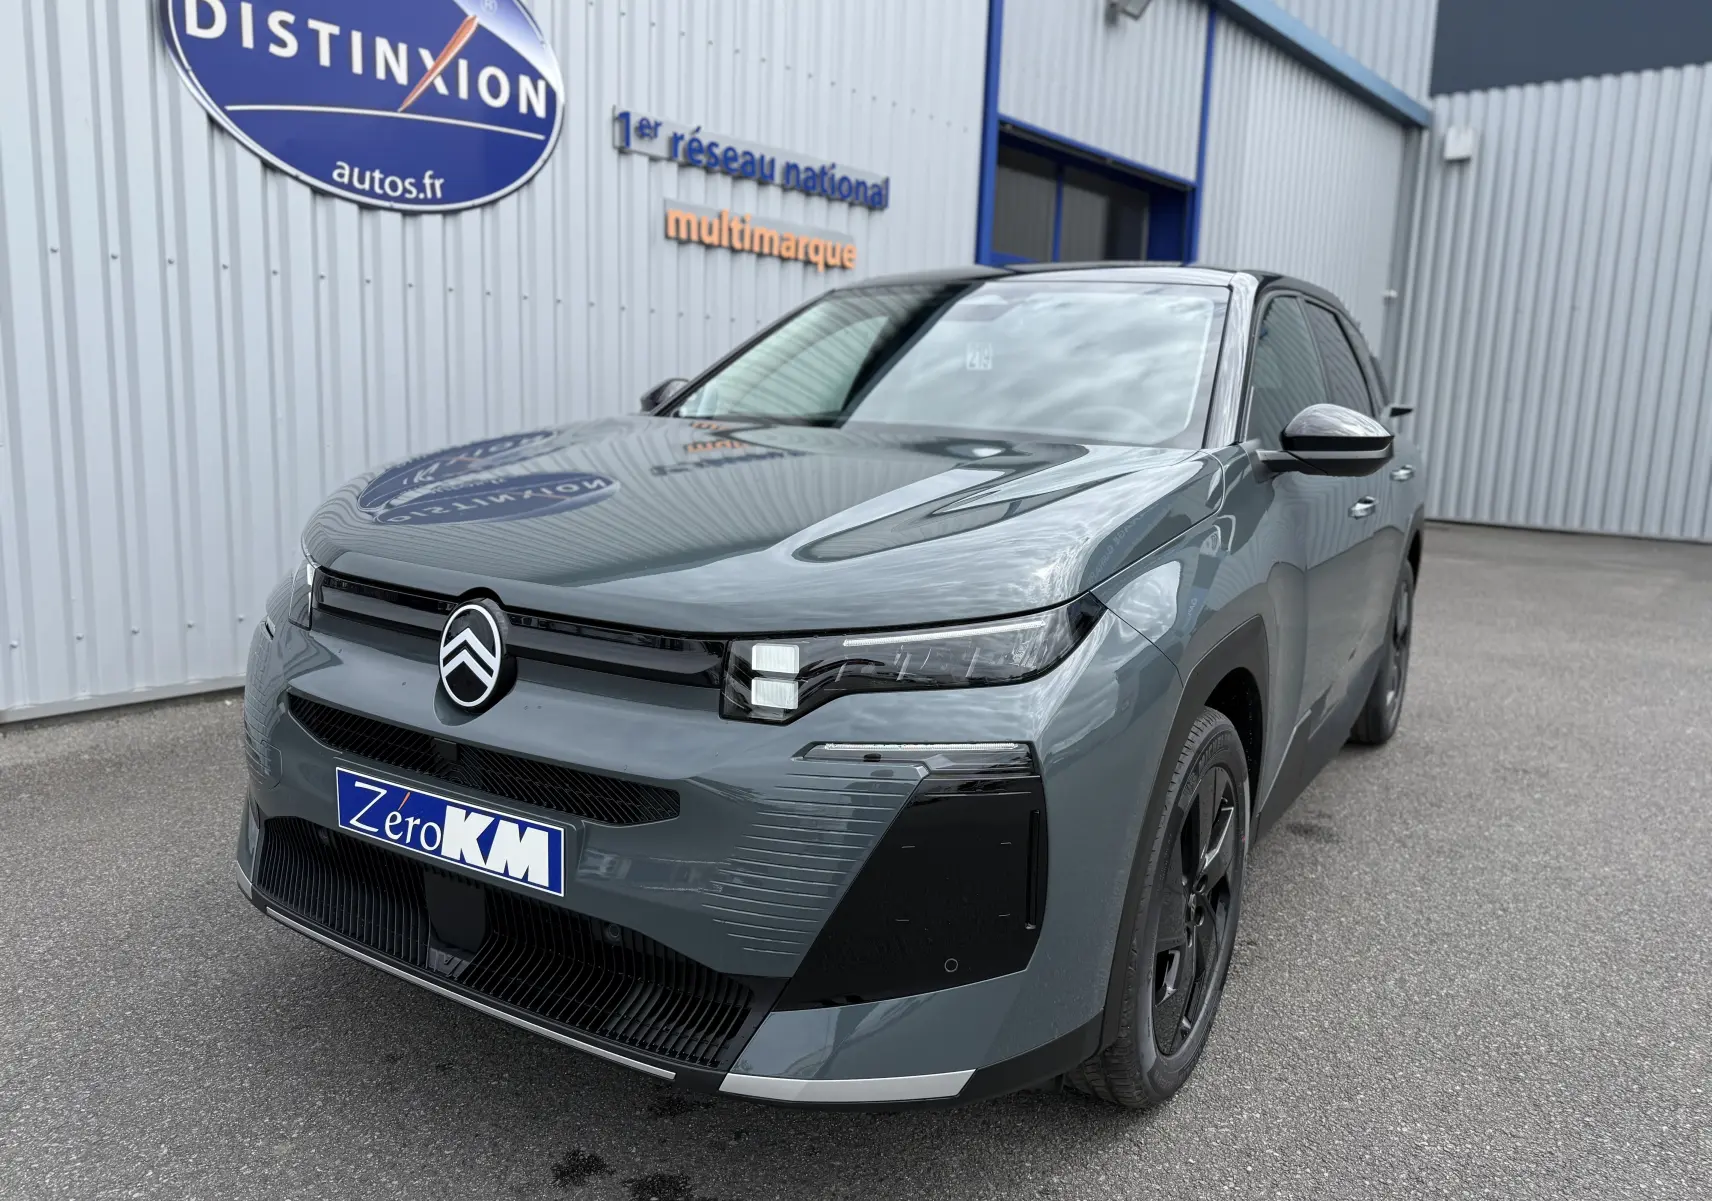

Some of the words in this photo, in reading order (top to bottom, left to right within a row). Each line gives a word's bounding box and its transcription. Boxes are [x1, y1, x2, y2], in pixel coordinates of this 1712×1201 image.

[185, 0, 546, 118] DISTINXION
[332, 161, 444, 199] autos.fr
[671, 126, 776, 182] réseau
[783, 163, 890, 209] national
[666, 209, 857, 272] multimarque
